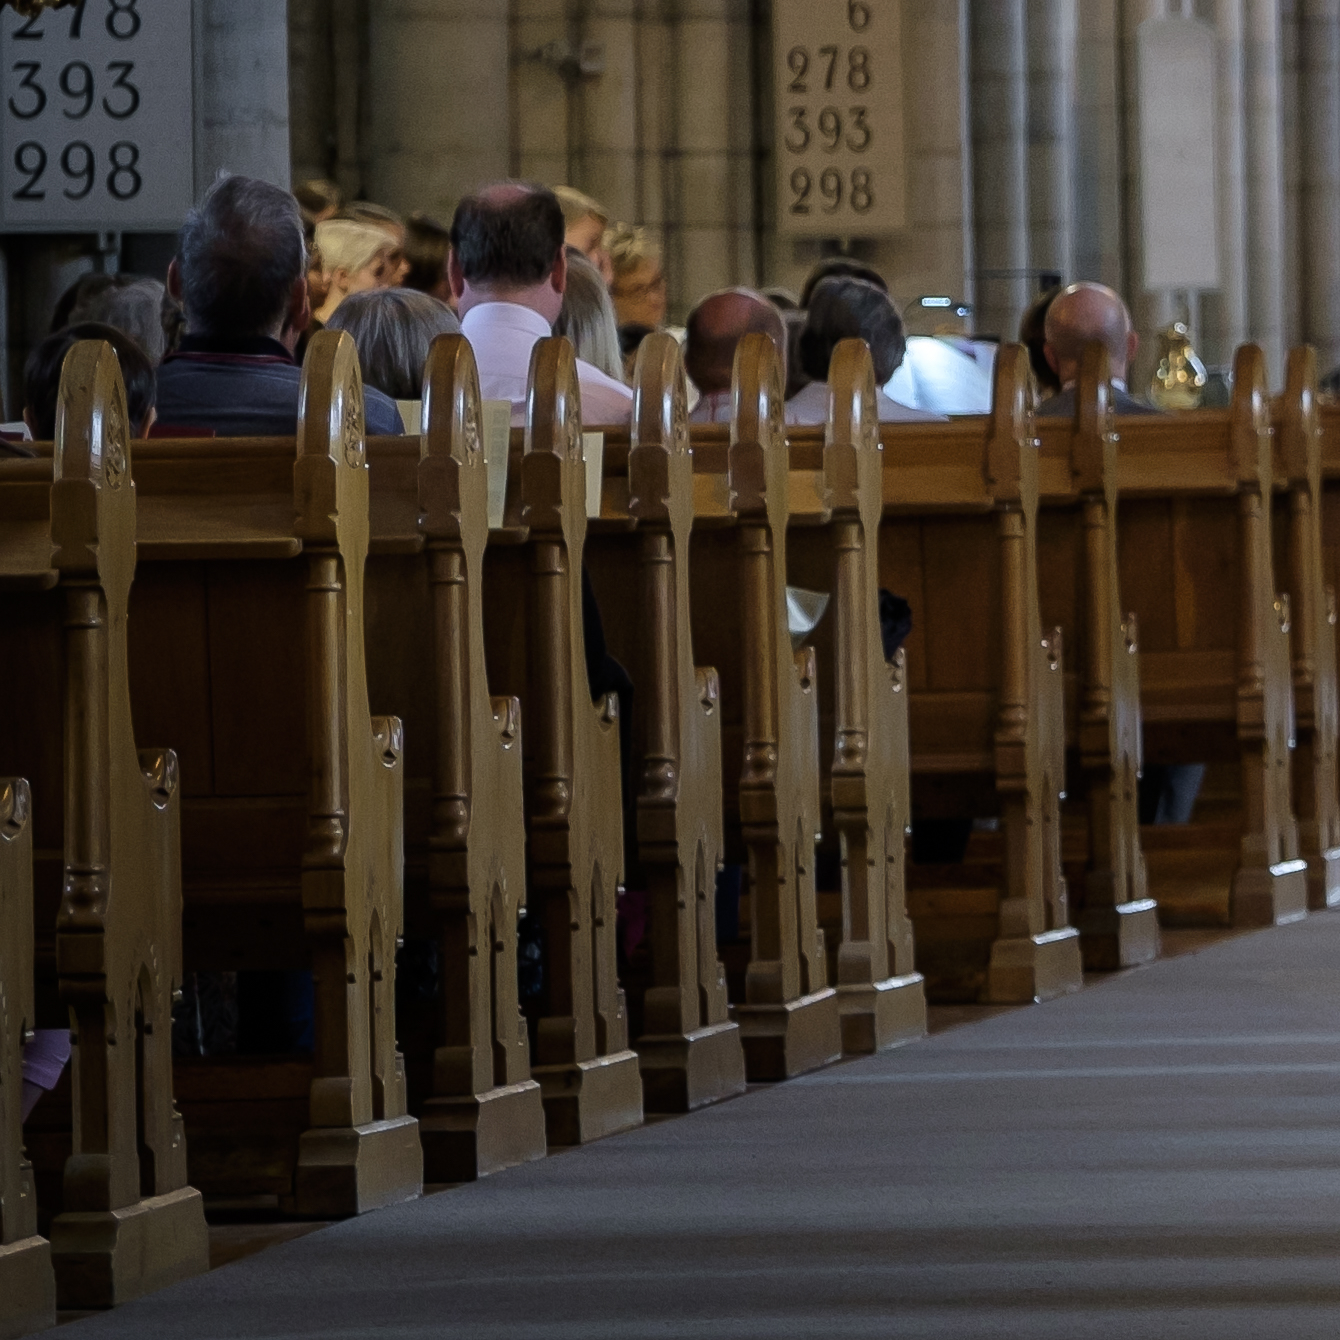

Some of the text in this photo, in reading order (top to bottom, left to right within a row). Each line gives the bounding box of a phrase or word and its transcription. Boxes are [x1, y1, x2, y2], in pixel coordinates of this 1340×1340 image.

[8, 60, 141, 120] 393
[787, 45, 872, 93] 278
[784, 106, 872, 154] 393
[12, 140, 142, 201] 298
[789, 165, 875, 216] 298
